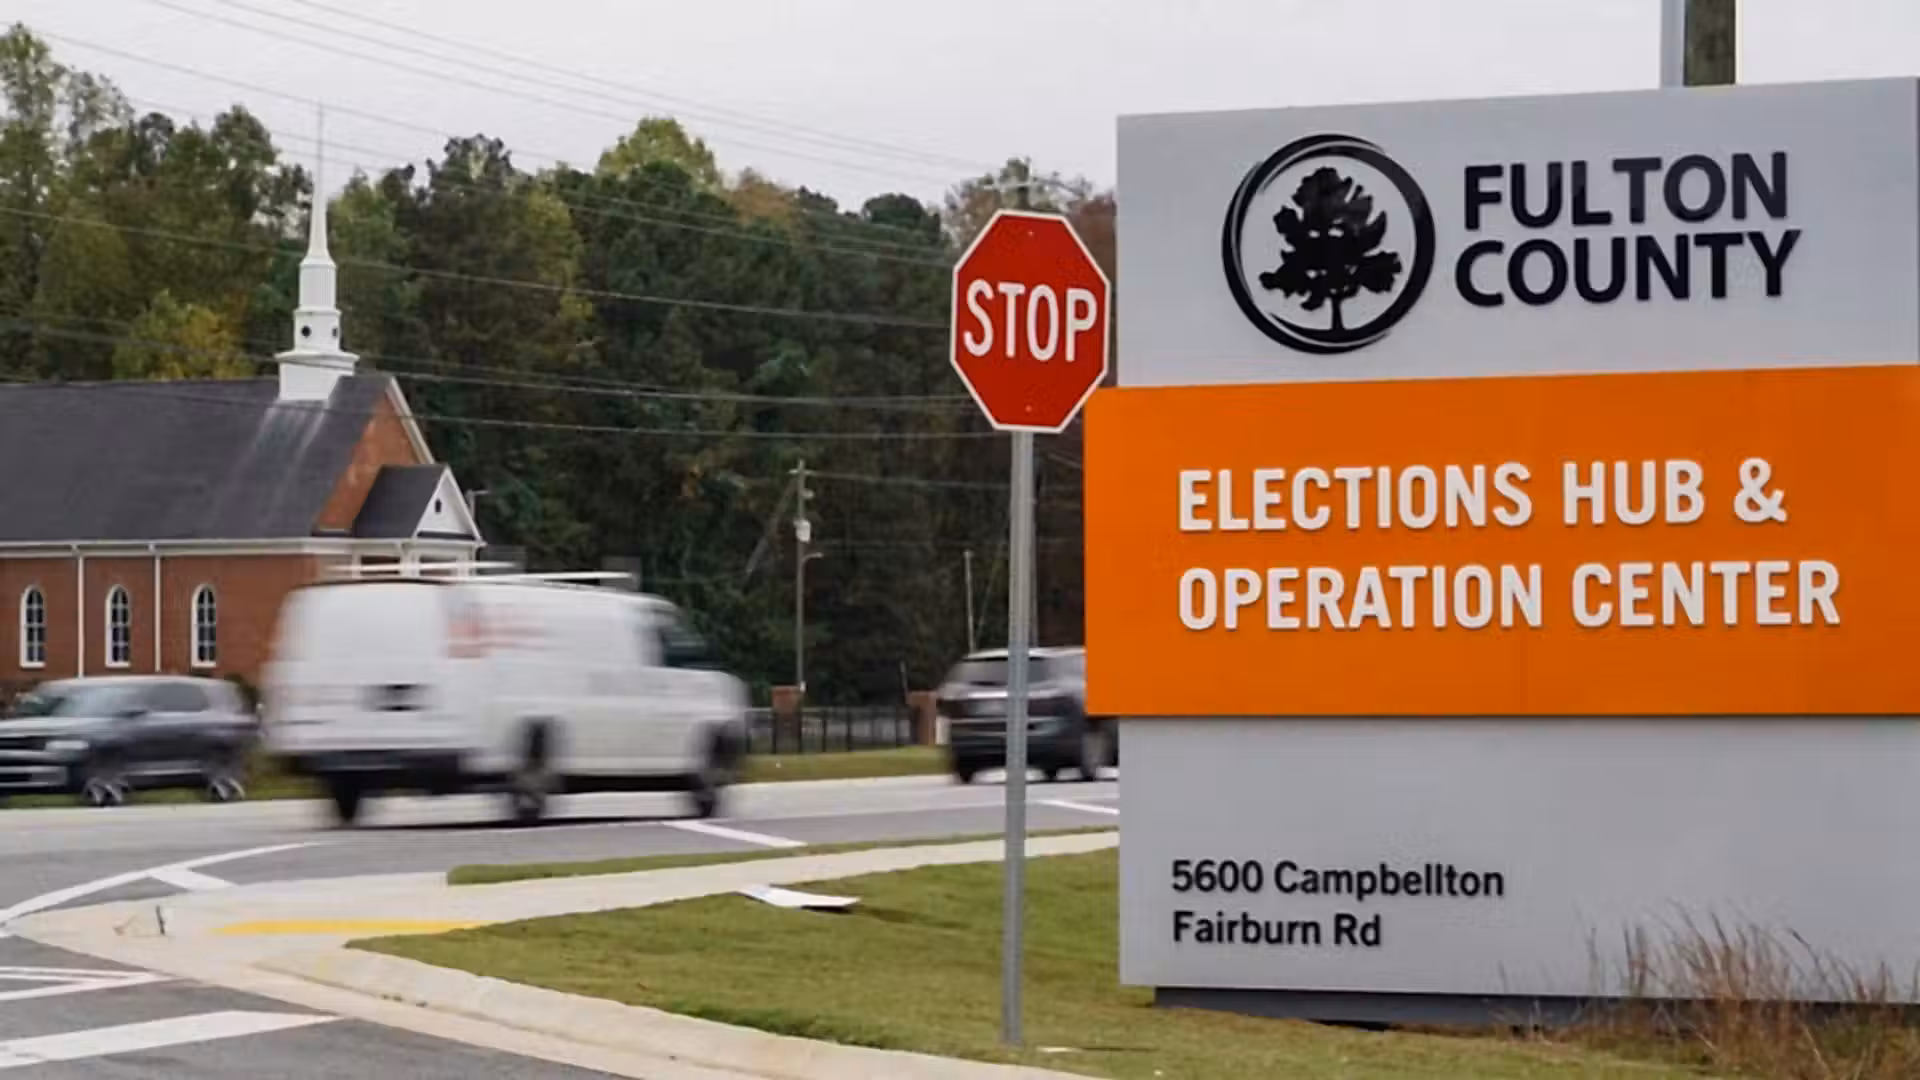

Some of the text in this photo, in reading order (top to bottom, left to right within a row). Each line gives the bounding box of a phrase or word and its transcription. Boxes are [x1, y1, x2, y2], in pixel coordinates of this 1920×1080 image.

[1464, 152, 1789, 232] FULTON
[1455, 229, 1802, 307] COUNTY
[963, 279, 1098, 363] STOP
[1178, 457, 1788, 532] ELECTIONS HUB &
[1178, 560, 1841, 631] OPERATION CENTER
[1172, 859, 1505, 902] 5600 Campbellton
[1173, 910, 1382, 947] Fairburn Rd
